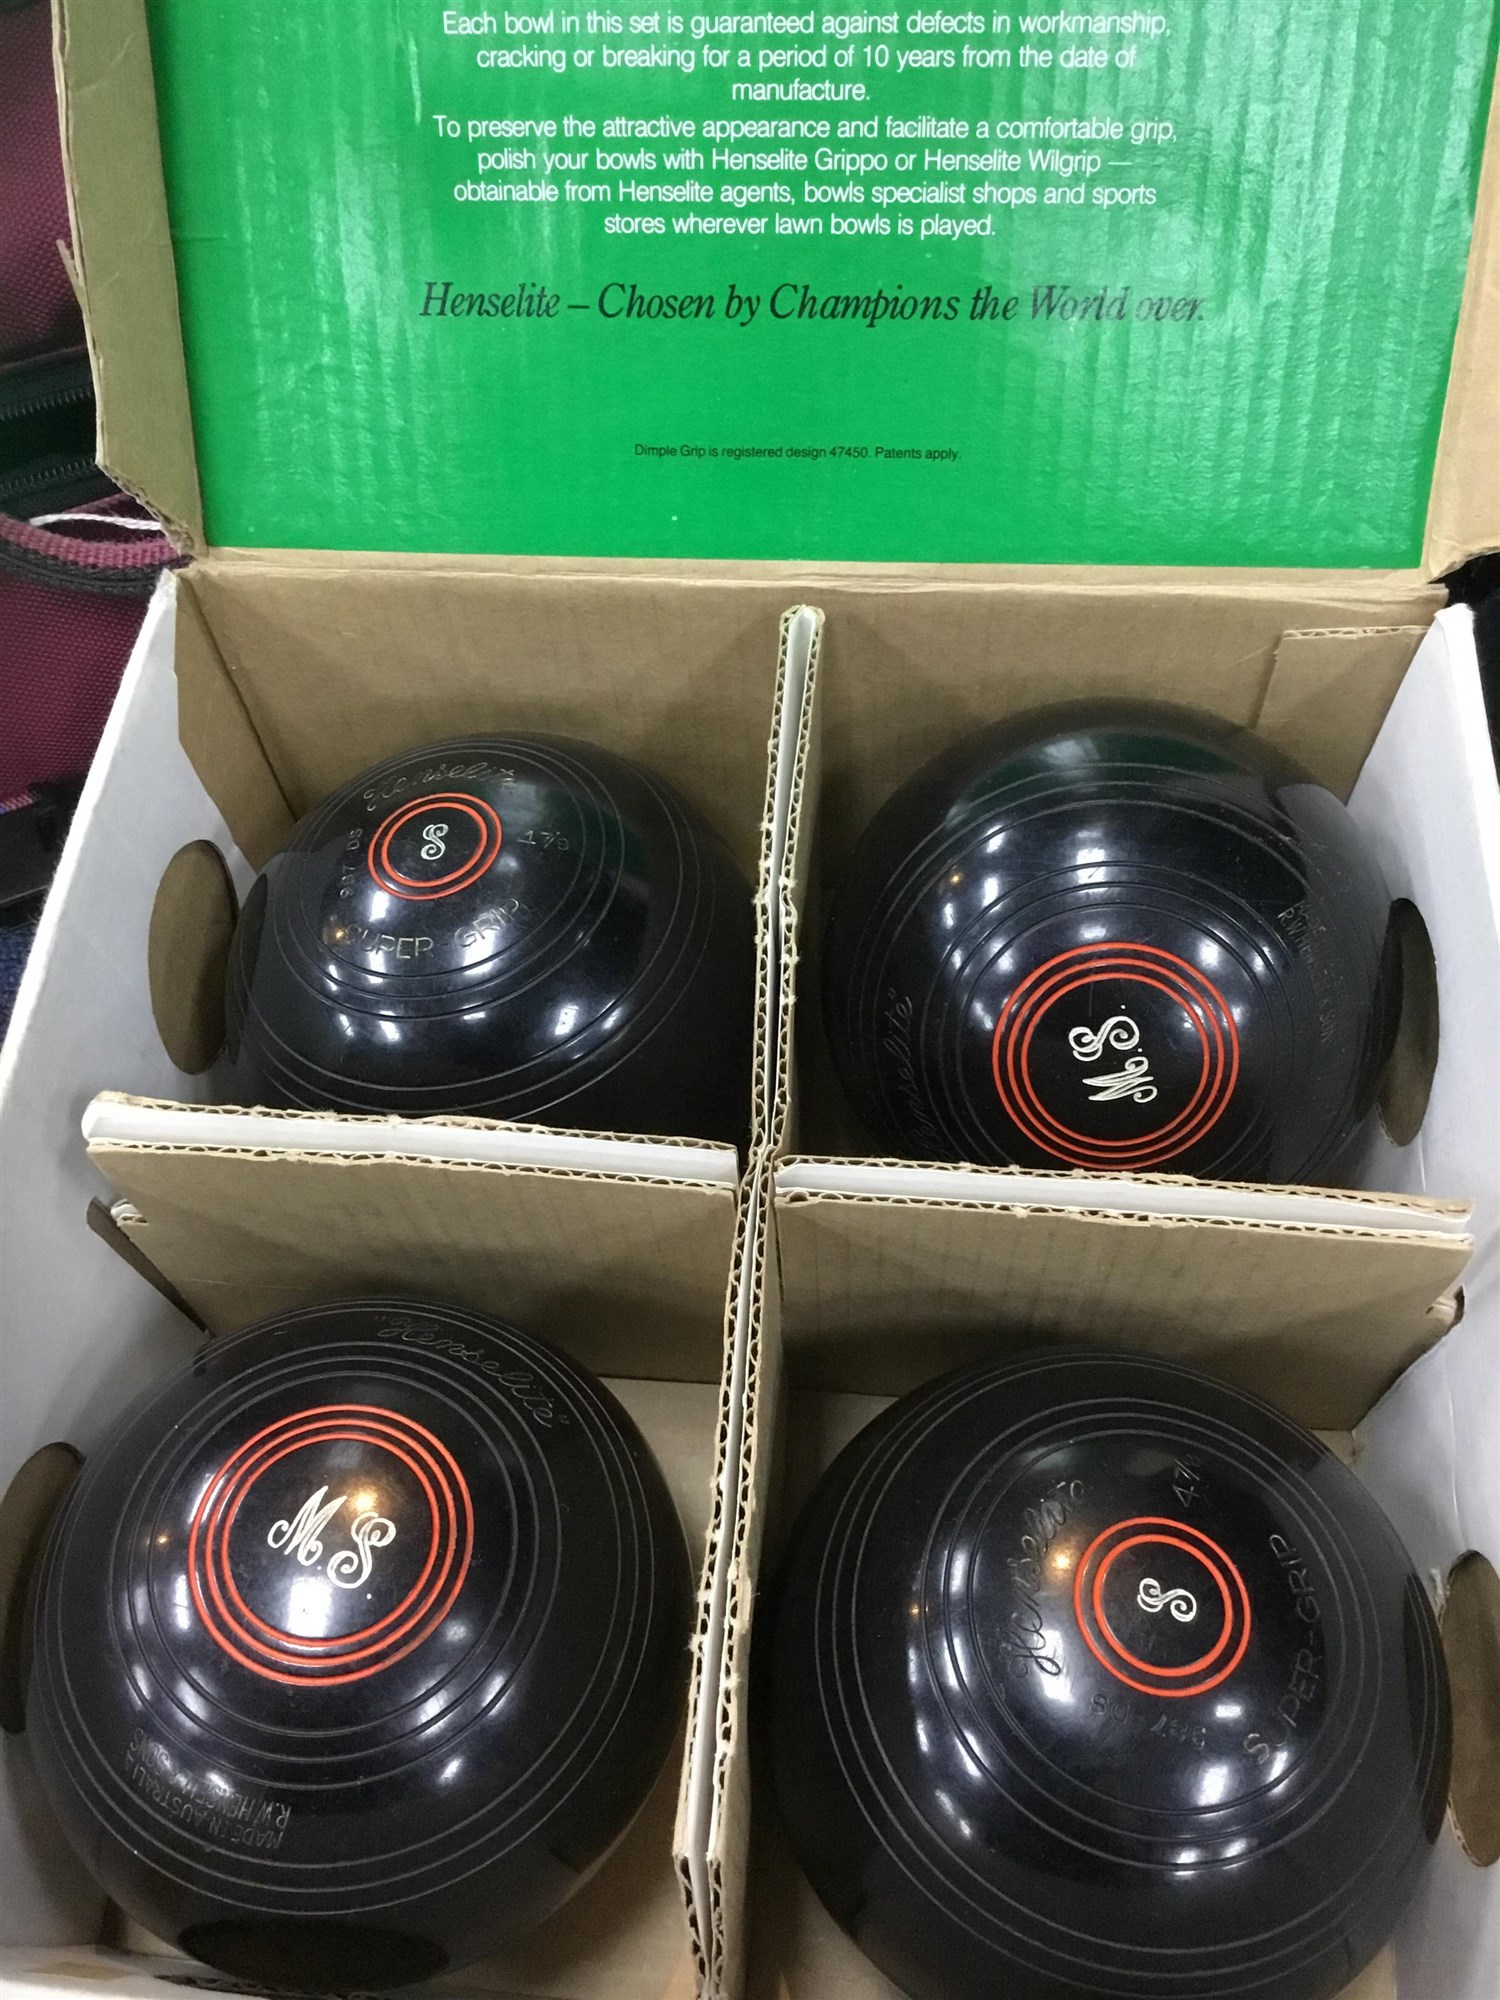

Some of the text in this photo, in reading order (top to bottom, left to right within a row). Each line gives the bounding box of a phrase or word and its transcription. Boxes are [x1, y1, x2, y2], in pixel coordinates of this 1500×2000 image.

[443, 10, 1171, 39] Each bowl in this set is guaranteed against defects in workmanship,
[477, 45, 1136, 73] cracking or breaking for a period of 10 years from the date of
[732, 79, 869, 101] manufacture.
[432, 115, 1176, 144] To preserve the attractive appearance and facilitate a comfortable grip,
[478, 148, 535, 174] polish
[543, 153, 588, 174] your
[597, 148, 656, 170] bowls
[663, 148, 703, 170] with
[713, 148, 808, 170] Henselite
[815, 148, 888, 175] Grippo
[895, 154, 916, 171] or
[925, 149, 1021, 171] Henselite
[1029, 150, 1101, 177] Wilgrip
[454, 180, 1156, 209] obtainable from Henselite agents, bowls specialist shops and sports
[604, 213, 995, 240] stores wherever lawn bowls is played.
[419, 282, 560, 318] Henselite
[598, 283, 715, 319] Chosen
[725, 284, 761, 327] by
[770, 283, 960, 328] Champions
[970, 286, 1018, 320] the
[1030, 285, 1130, 321] World
[1135, 297, 1204, 321] over.
[634, 444, 677, 458] Dimple
[680, 445, 705, 459] Grip
[709, 446, 719, 457] is
[722, 446, 783, 460] registered
[786, 446, 826, 460] design
[830, 447, 871, 458] 47450.
[875, 447, 921, 459] Patents
[122, 1749, 208, 1826] AUSTRALIA
[230, 1823, 284, 1850] MADE
